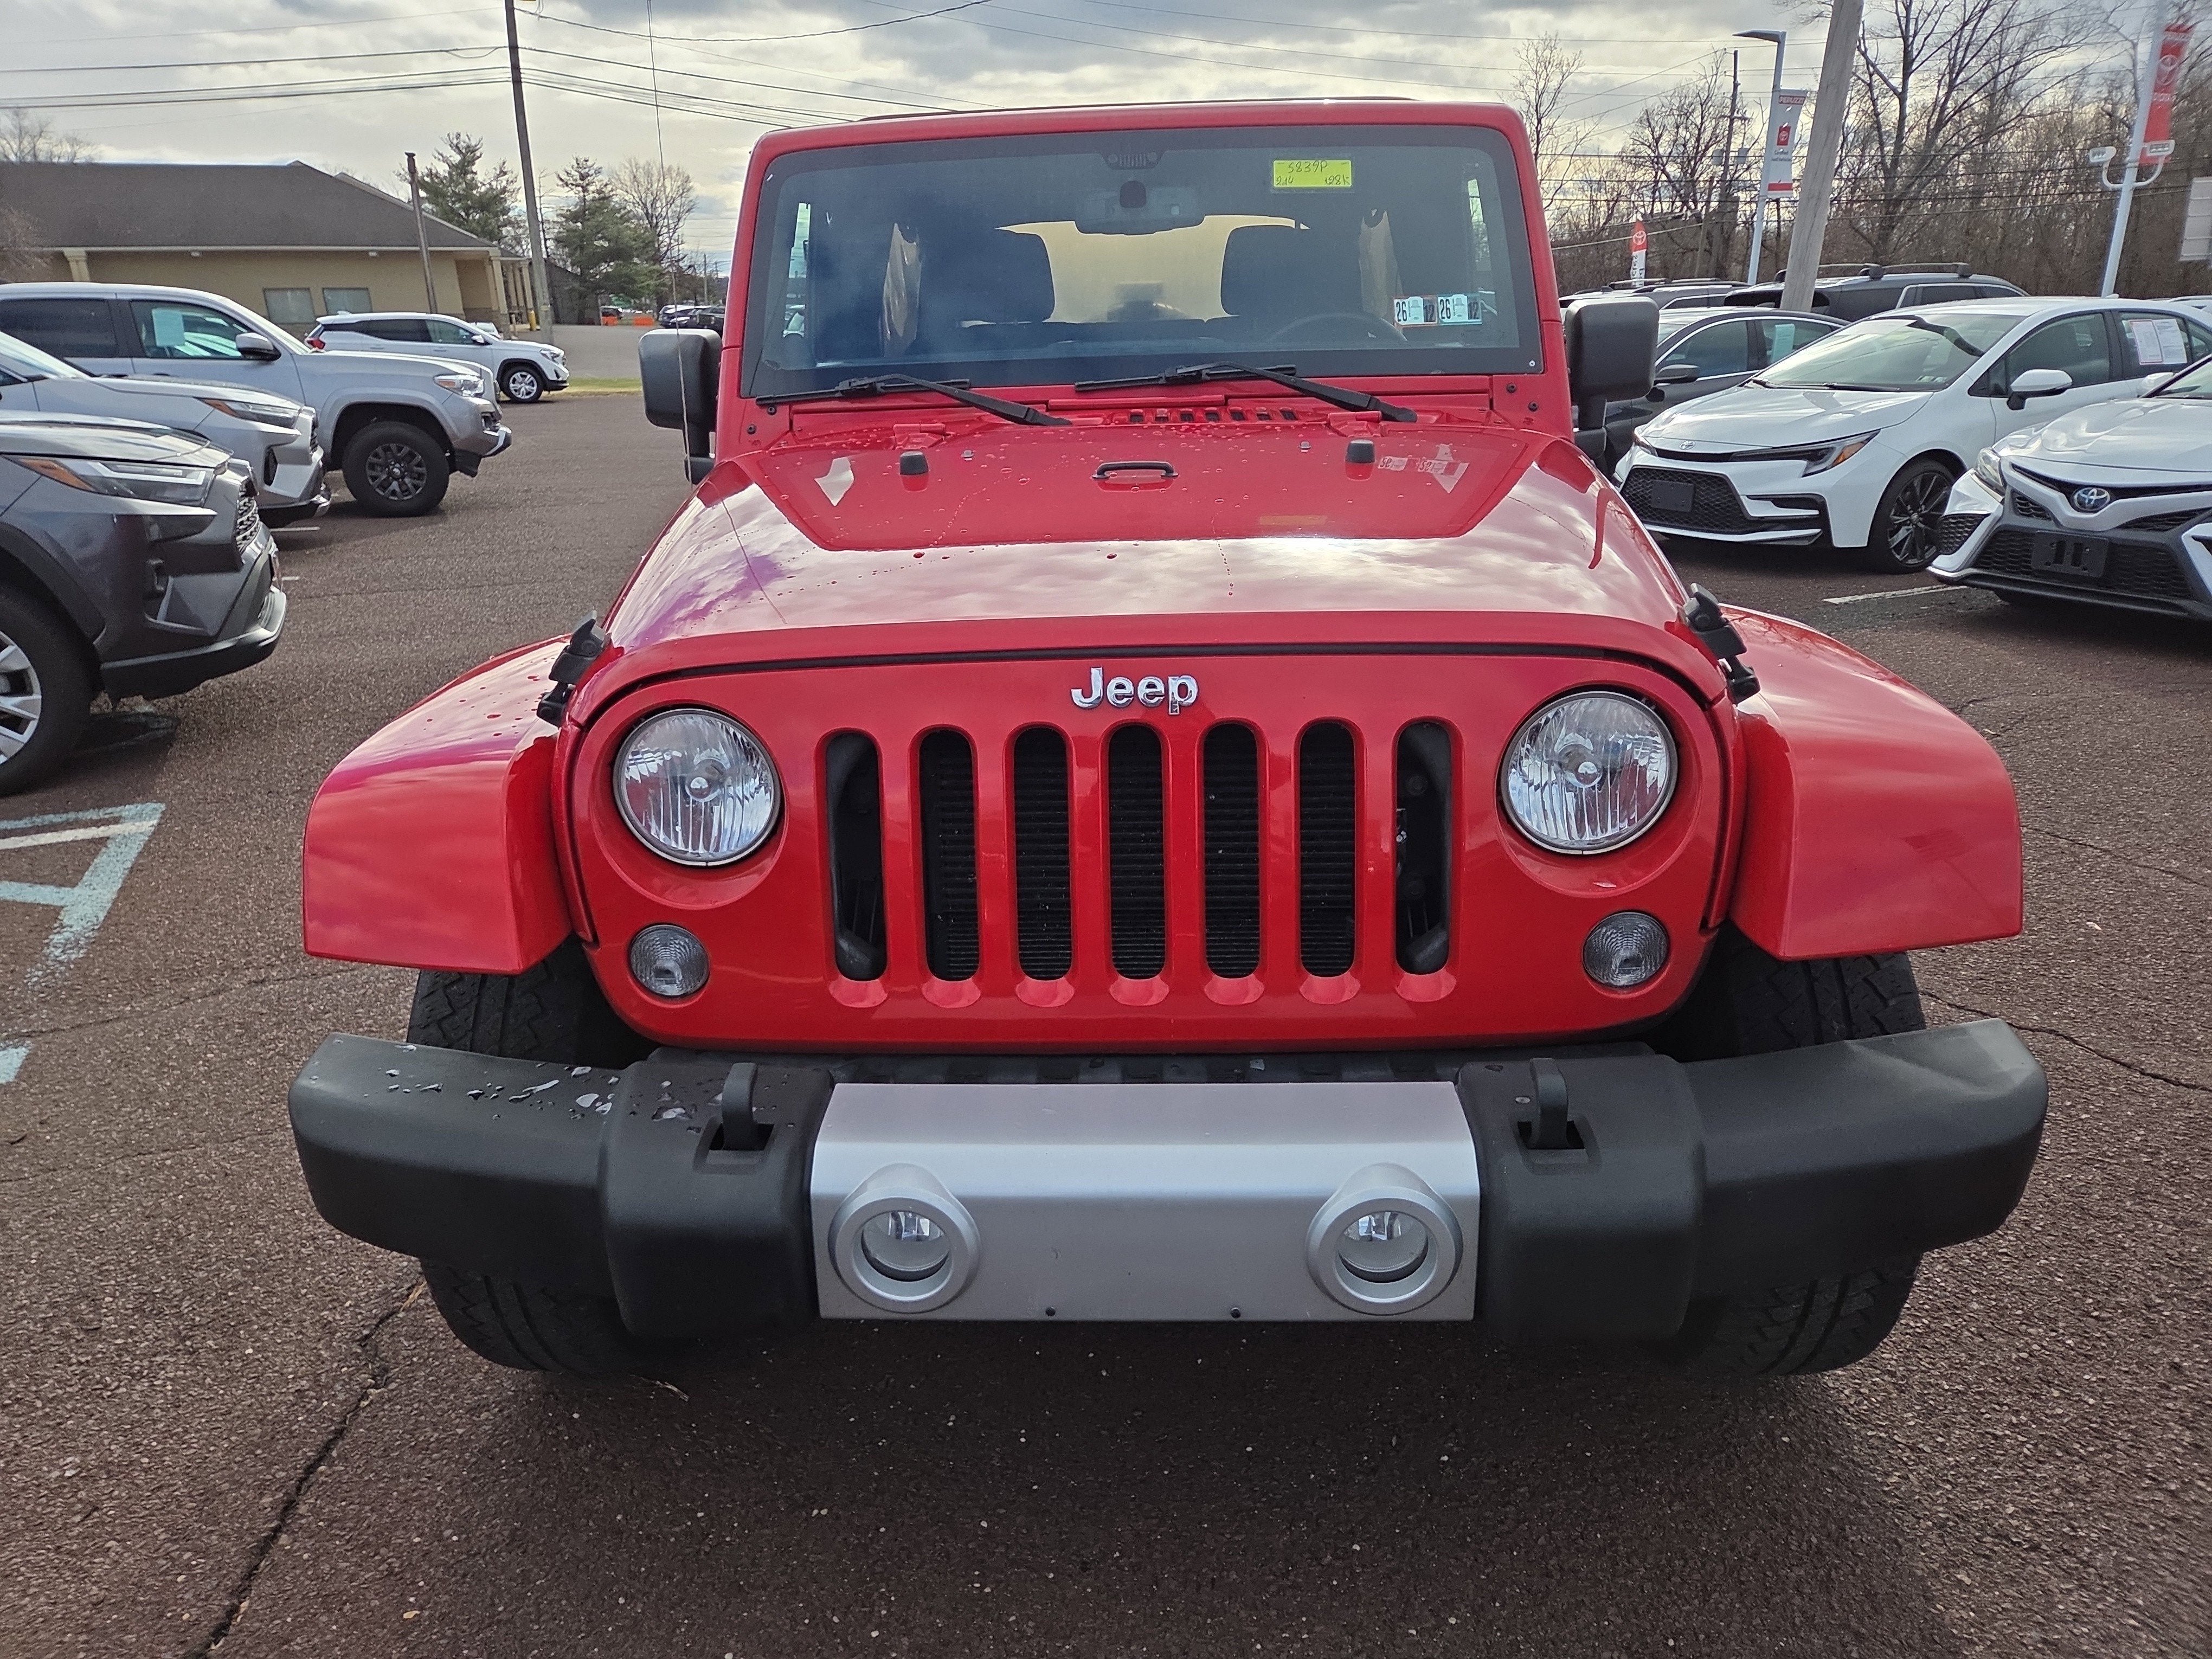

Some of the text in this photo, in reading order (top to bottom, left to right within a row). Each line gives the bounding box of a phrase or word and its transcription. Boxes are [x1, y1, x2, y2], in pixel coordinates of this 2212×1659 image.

[1396, 301, 1407, 322] 26
[1424, 304, 1435, 322] 12
[1439, 299, 1451, 319] 26
[1468, 301, 1479, 320] 12
[1070, 666, 1199, 716] Jeep
